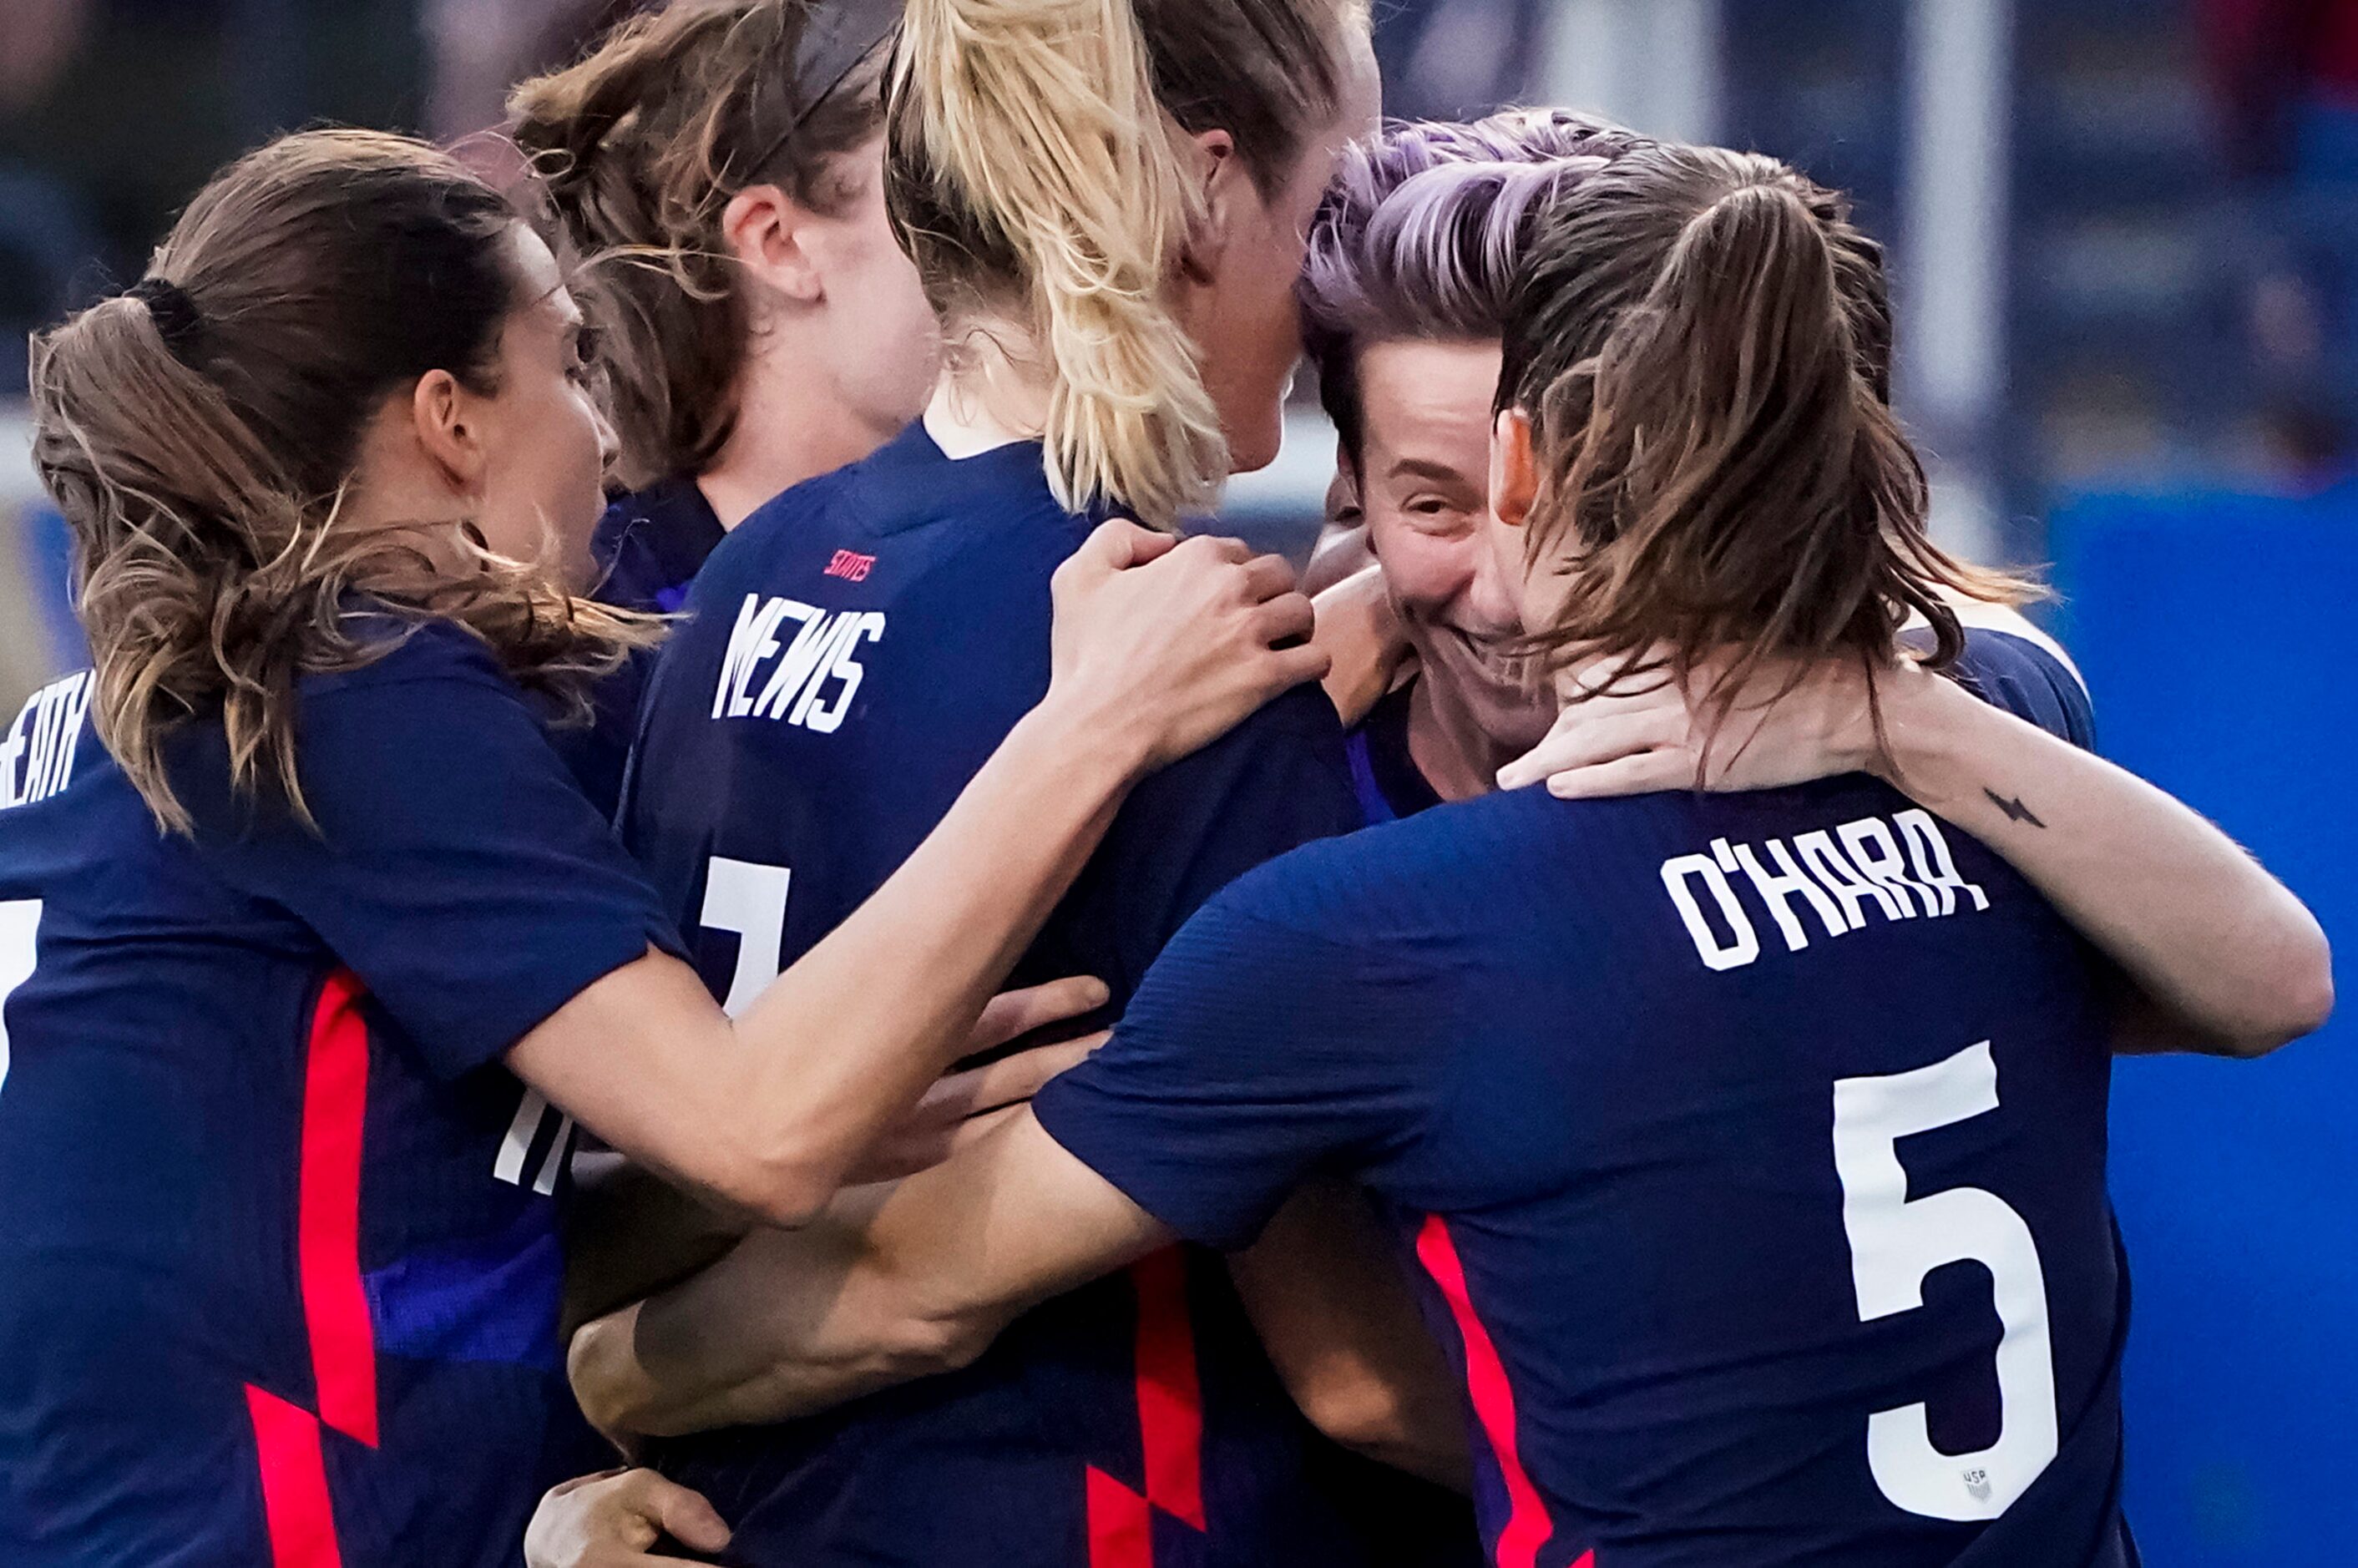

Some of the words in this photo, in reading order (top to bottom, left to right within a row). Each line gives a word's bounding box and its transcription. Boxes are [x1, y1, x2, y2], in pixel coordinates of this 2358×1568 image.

[0, 668, 97, 810] EATH
[711, 594, 885, 733] MEWIS
[1660, 808, 1990, 971] O'HARA
[1833, 1040, 2058, 1521] 5
